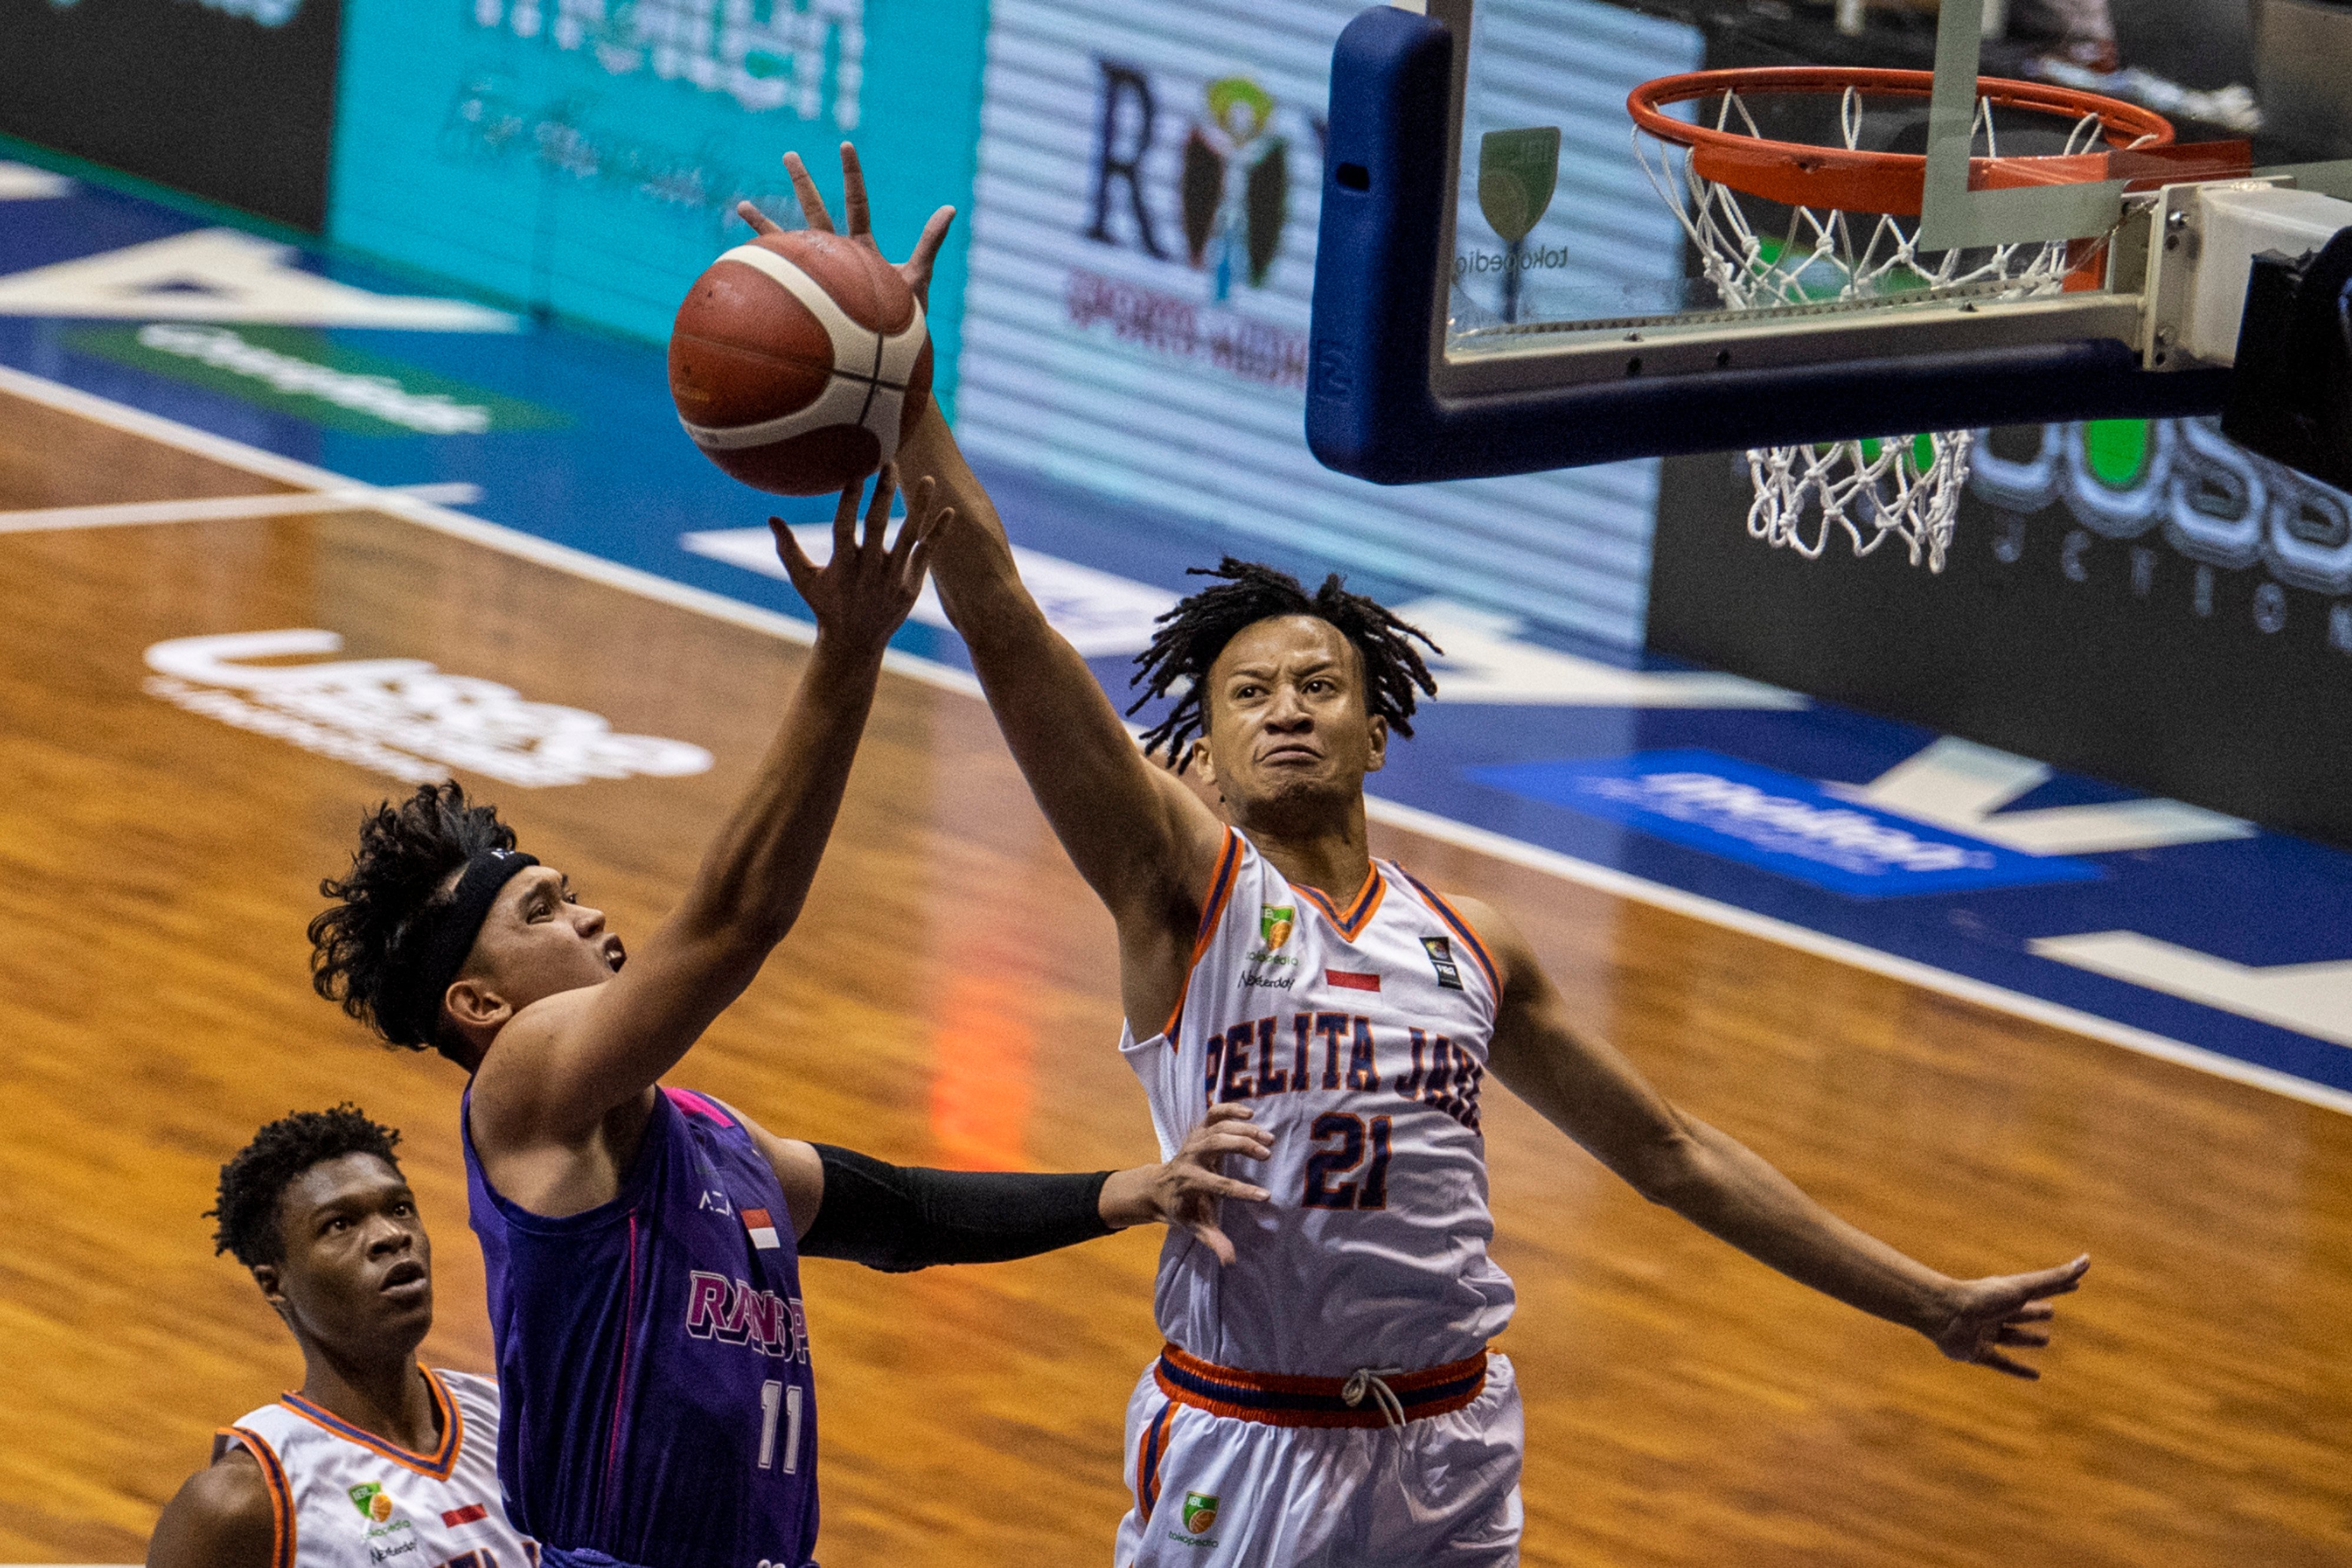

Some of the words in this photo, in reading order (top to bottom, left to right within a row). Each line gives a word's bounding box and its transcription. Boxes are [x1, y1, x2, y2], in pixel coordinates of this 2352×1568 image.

[1301, 1111, 1392, 1211] 21
[757, 1379, 802, 1475] 11
[1188, 1496, 1204, 1509] IBL
